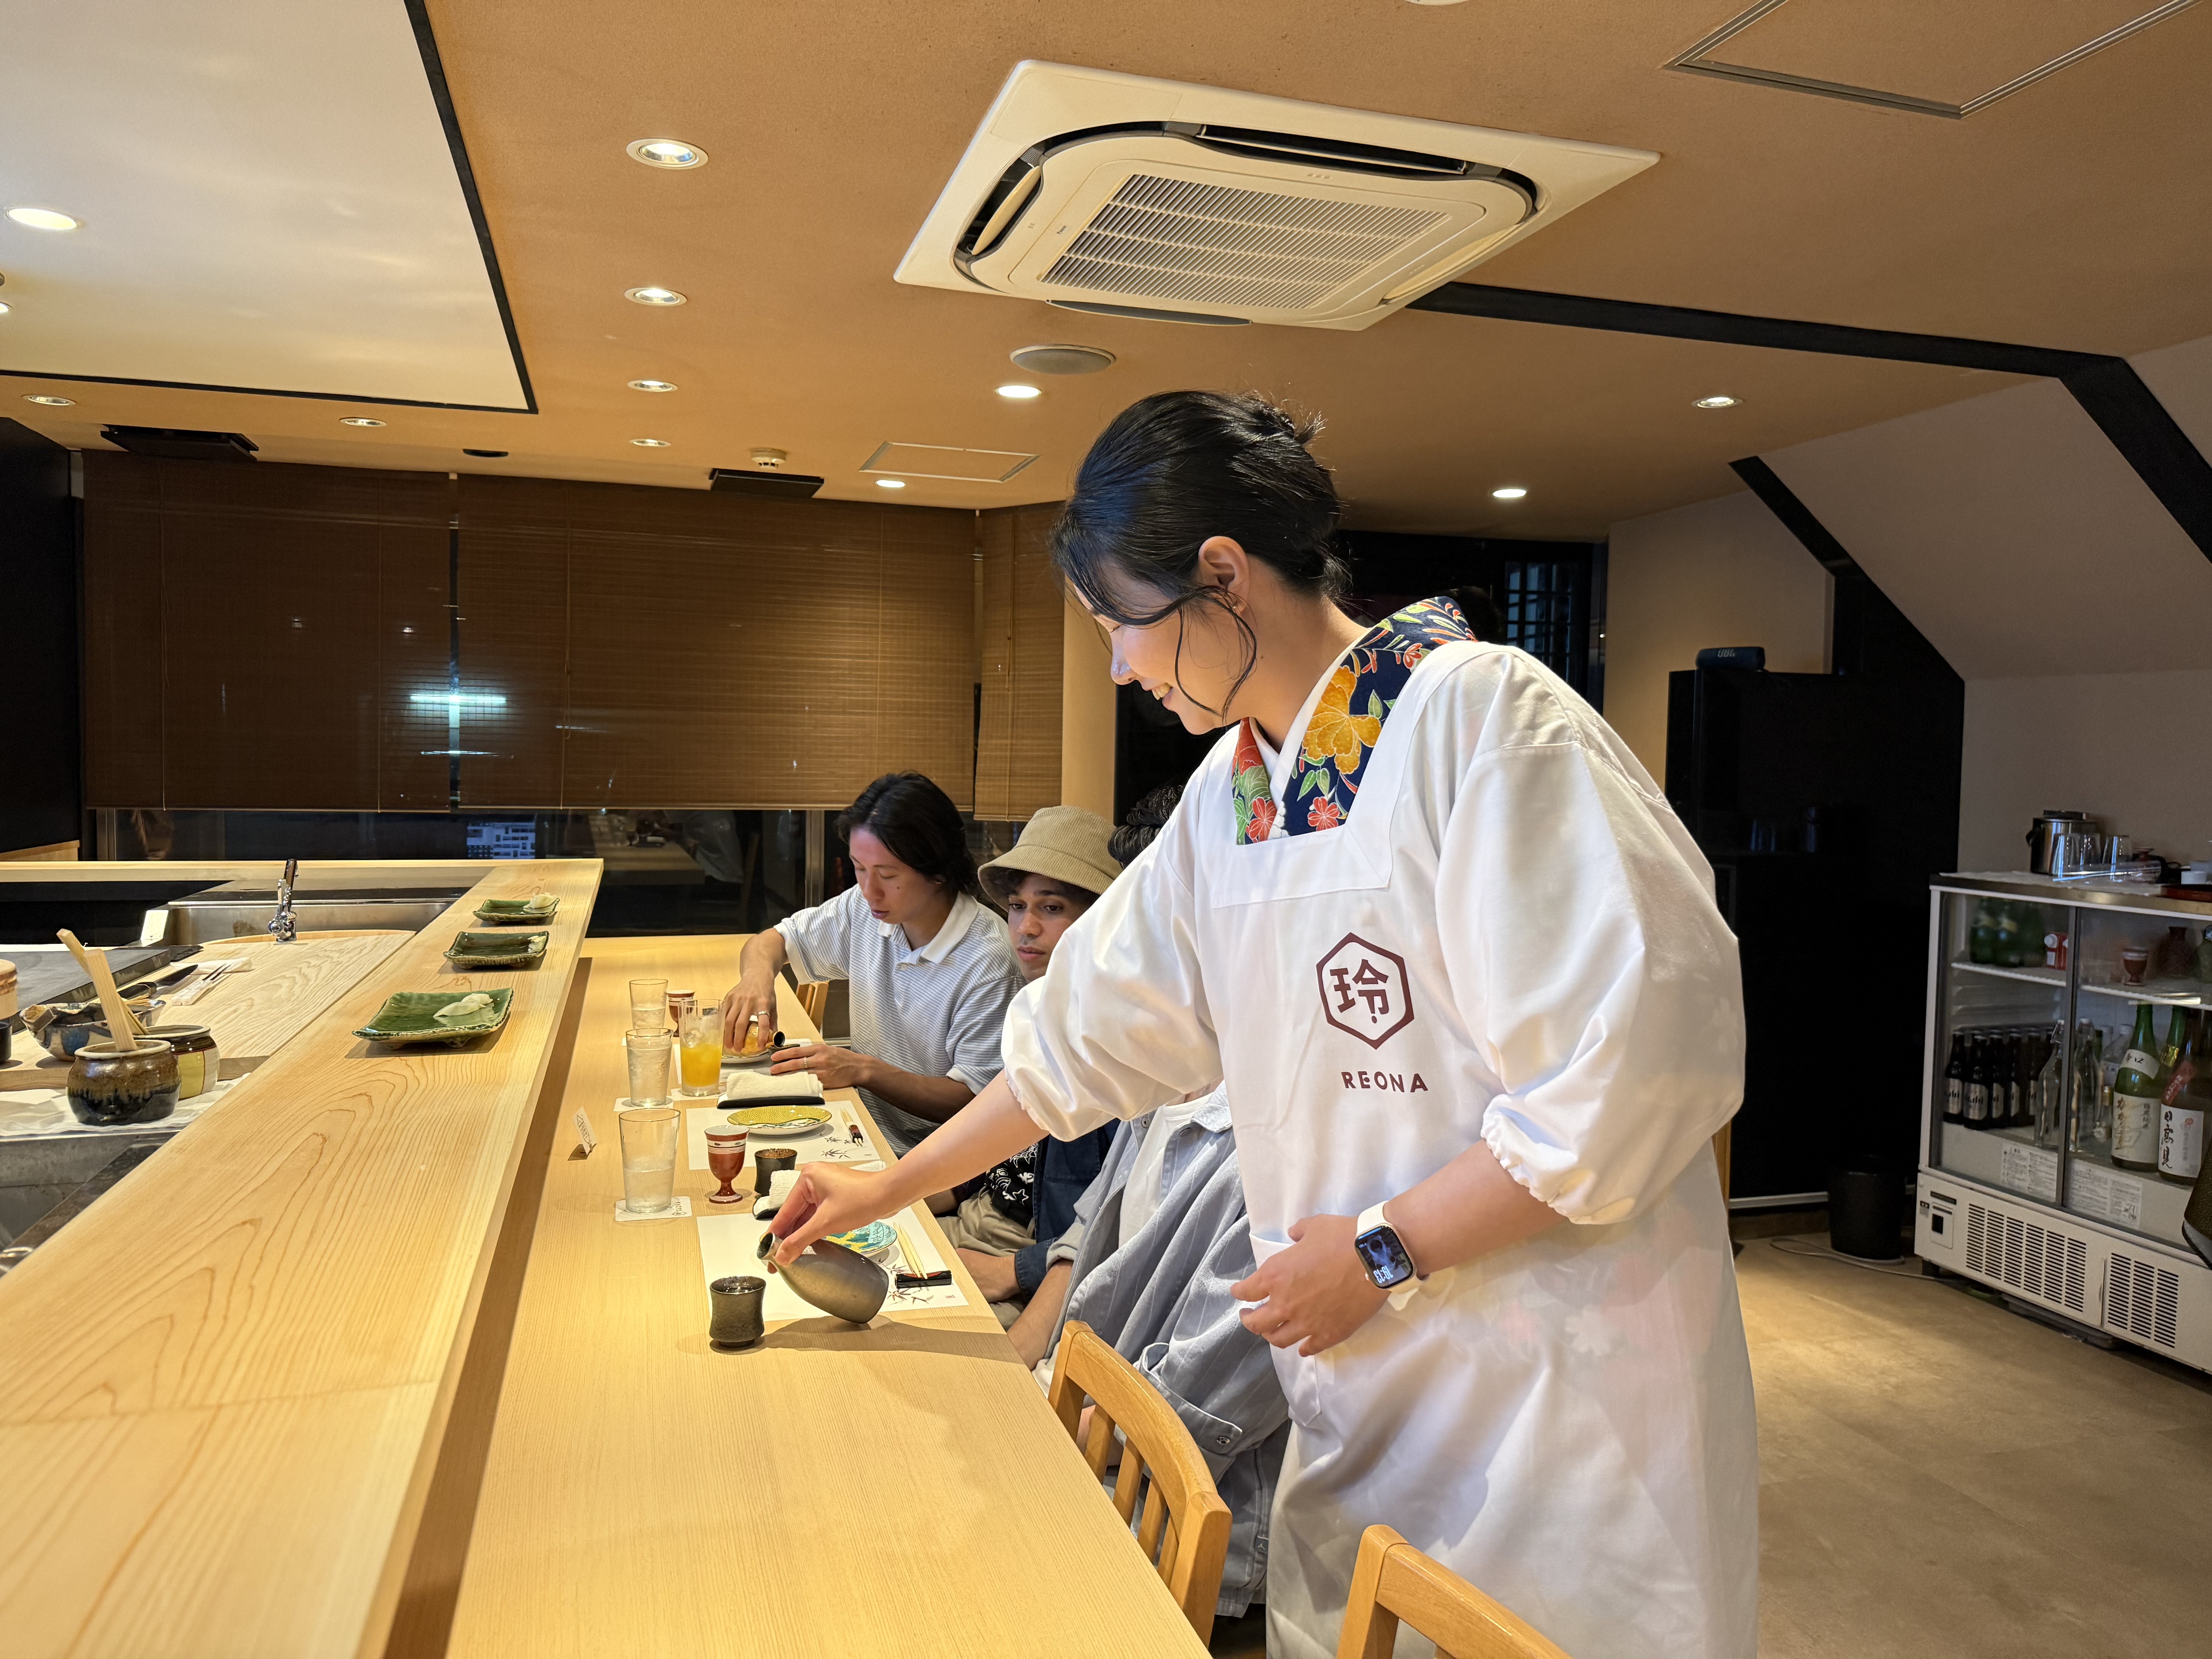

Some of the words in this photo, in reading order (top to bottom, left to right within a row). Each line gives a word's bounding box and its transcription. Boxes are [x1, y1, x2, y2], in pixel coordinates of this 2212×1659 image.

[1329, 959, 1389, 1024] 玲
[1341, 1071, 1428, 1093] REONA
[1373, 1265, 1394, 1283] 19:13
